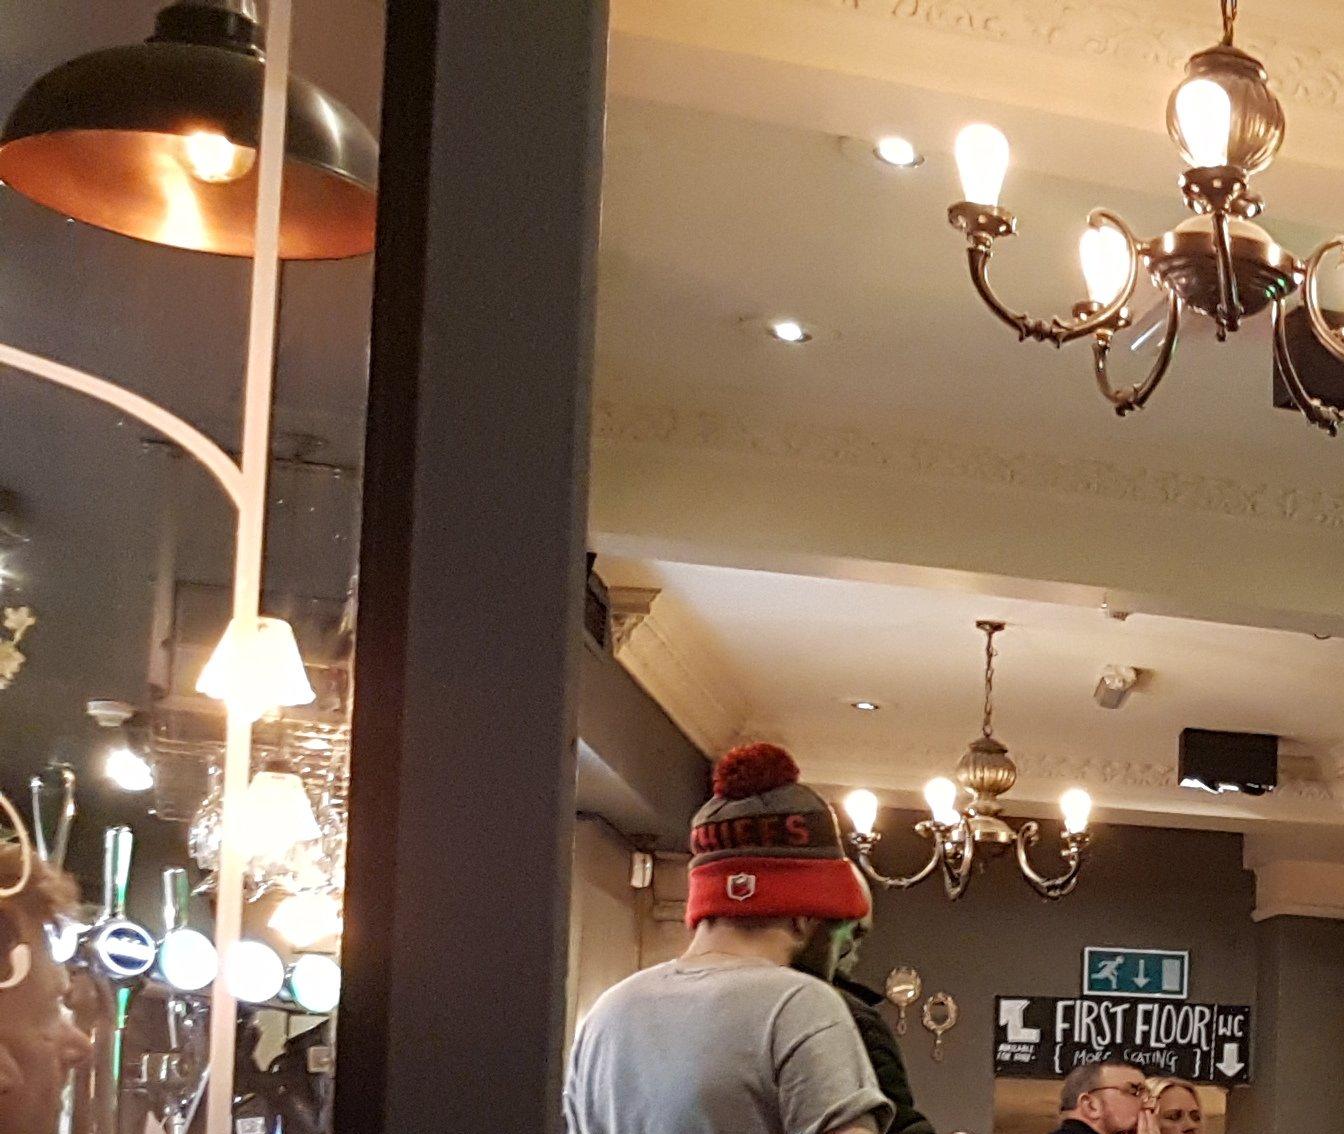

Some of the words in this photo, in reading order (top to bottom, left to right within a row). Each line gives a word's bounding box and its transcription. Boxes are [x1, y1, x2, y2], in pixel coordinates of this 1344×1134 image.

[1055, 1000, 1131, 1050] FIRST
[1134, 1002, 1211, 1050] FLOOR
[1217, 1014, 1245, 1037] WC
